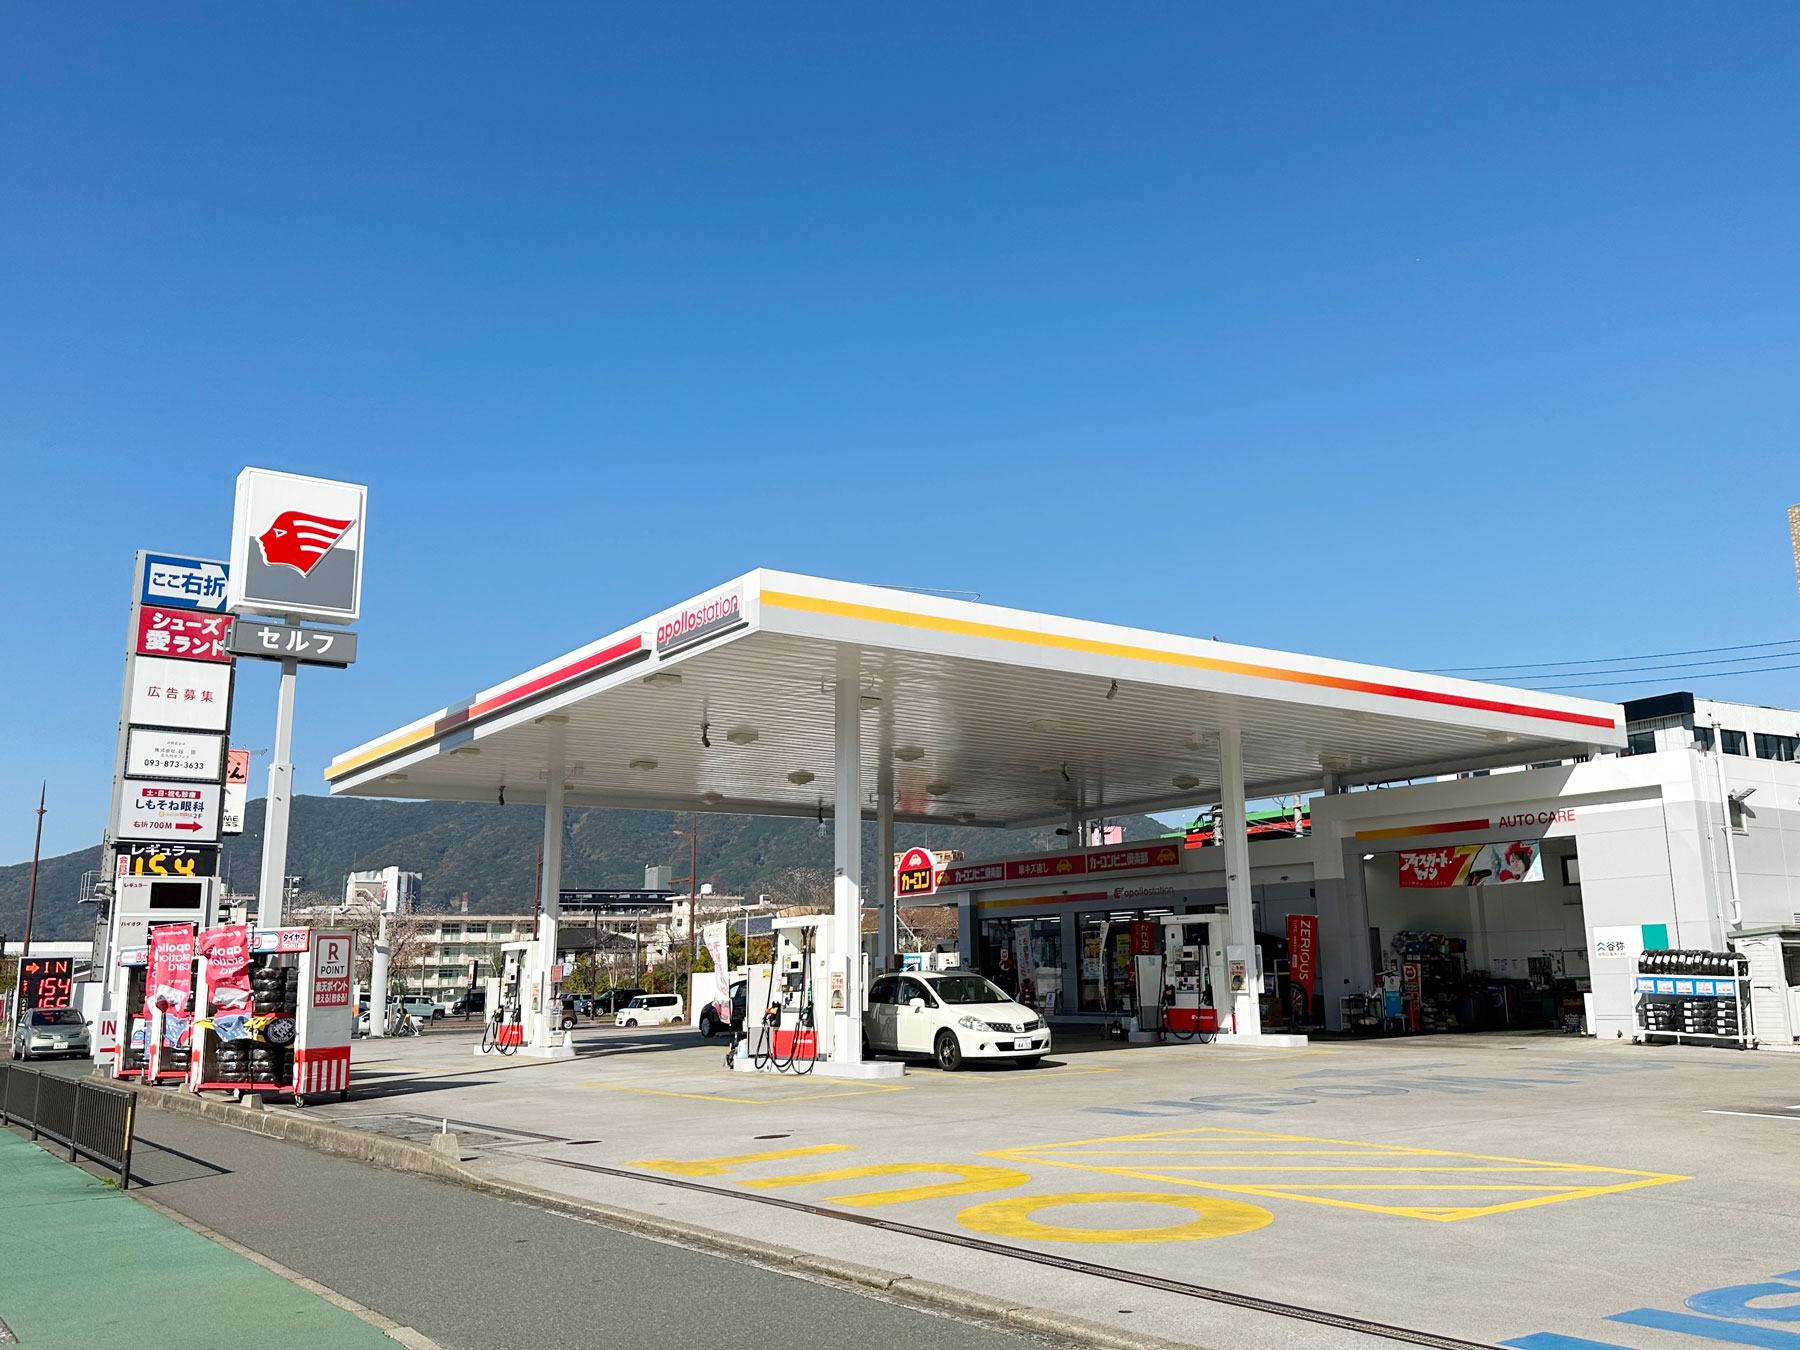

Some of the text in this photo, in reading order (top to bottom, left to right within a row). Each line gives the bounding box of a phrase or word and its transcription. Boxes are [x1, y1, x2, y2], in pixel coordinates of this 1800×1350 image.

[152, 572, 226, 598] ここ右折
[152, 612, 222, 636] シューズ
[658, 595, 738, 644] apollostation
[145, 629, 224, 656] 愛ランド
[258, 626, 334, 654] セルフ
[148, 686, 214, 702] 広告募集
[144, 759, 204, 769] 093-873-3633
[136, 799, 204, 812] しもそね眼科
[134, 821, 172, 829] 右折700M
[1499, 810, 1576, 828] AUTO CARE
[132, 844, 200, 856] レギュラー
[1400, 850, 1448, 871] アイスガード
[902, 871, 929, 891] カーコン
[1124, 886, 1174, 898] apollostation
[328, 942, 339, 960] R
[1299, 920, 1310, 980] ZERIOUS
[44, 961, 67, 973] IN
[321, 966, 345, 974] POINT
[38, 978, 71, 996] 154
[316, 981, 348, 992] 楽天ポイント
[101, 1020, 116, 1035] IN
